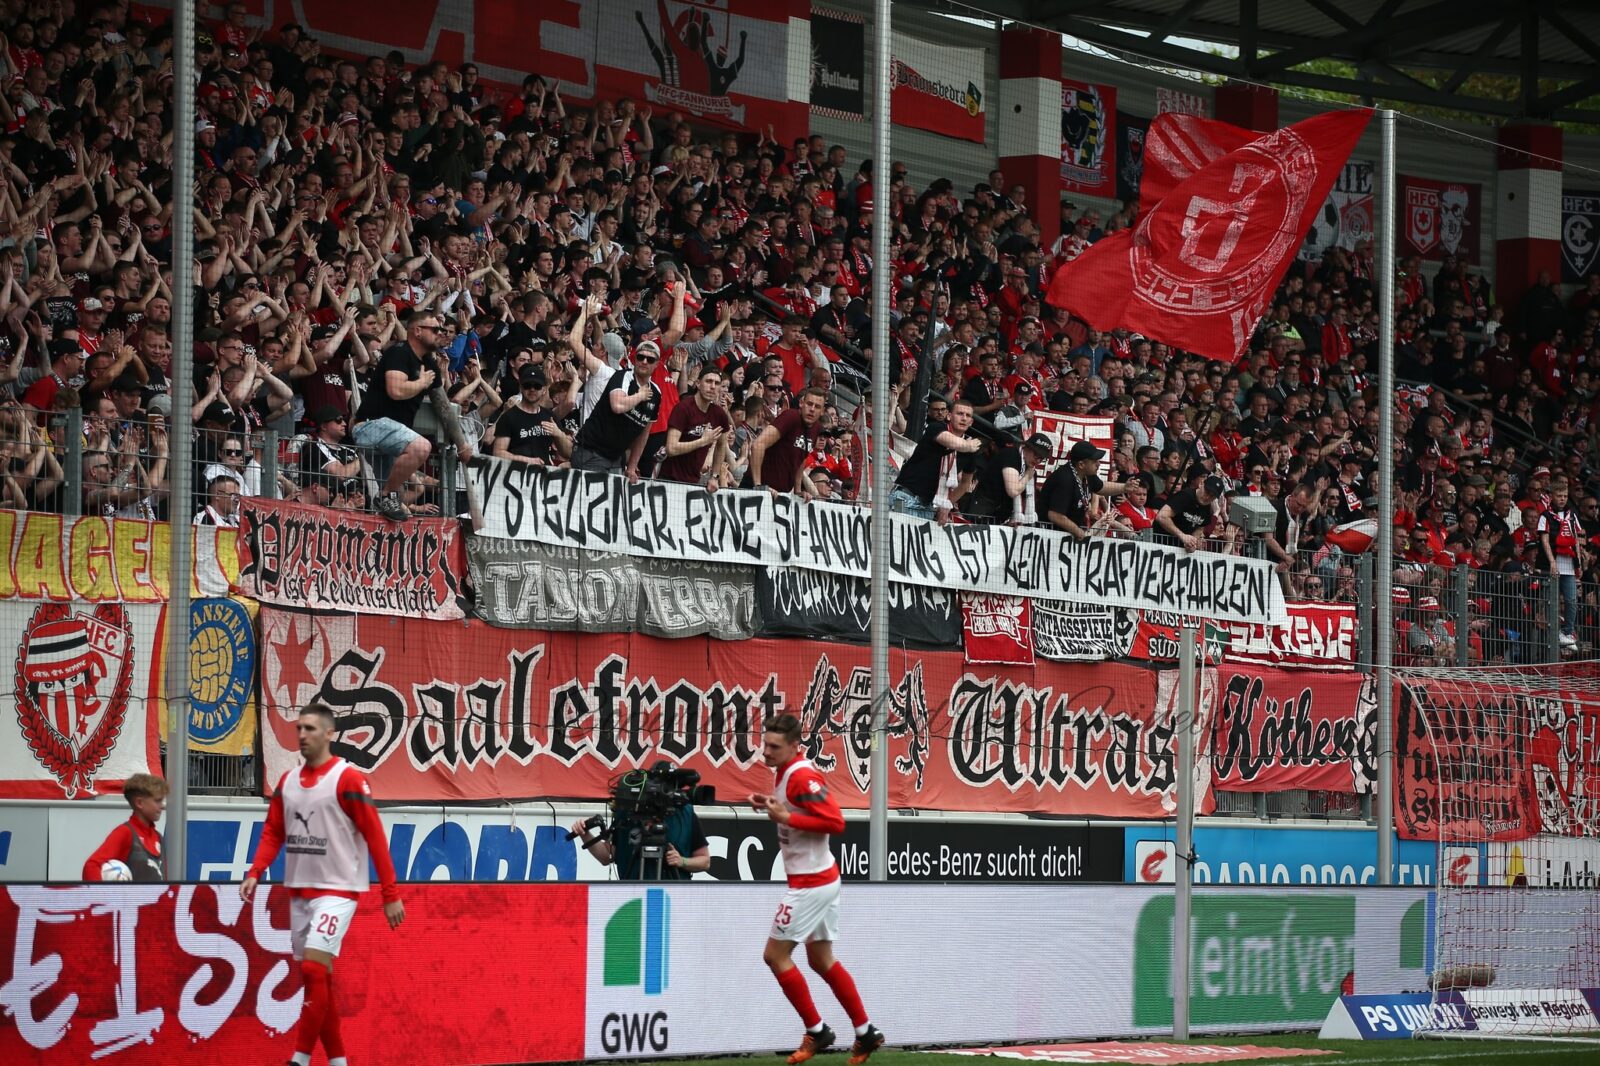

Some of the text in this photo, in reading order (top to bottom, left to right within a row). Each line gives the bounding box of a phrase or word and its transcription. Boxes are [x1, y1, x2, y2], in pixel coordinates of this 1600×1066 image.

[656, 84, 732, 109] HFC-FANKURVE
[1409, 190, 1438, 207] HFC
[1563, 199, 1595, 213] HFC
[243, 505, 439, 598] Pyromanie
[685, 489, 764, 560] EINE
[772, 494, 946, 582] SV-ANHÖUNG
[943, 523, 992, 586] IST
[1000, 527, 1051, 591] KEIN
[1057, 534, 1272, 621] STRAFVERFAHREN!
[283, 569, 438, 616] ist Leidenschaft
[85, 618, 118, 652] HFC
[193, 603, 250, 663] ANSZENE
[853, 671, 871, 698] HF
[311, 643, 786, 771] Saalefront
[840, 842, 1083, 878] Meedes-Benz sucht dich!
[316, 912, 340, 937] 26
[774, 902, 794, 926] 25
[600, 1010, 669, 1055] GWG
[1360, 1000, 1589, 1033] PS UNION bewegt die Region
